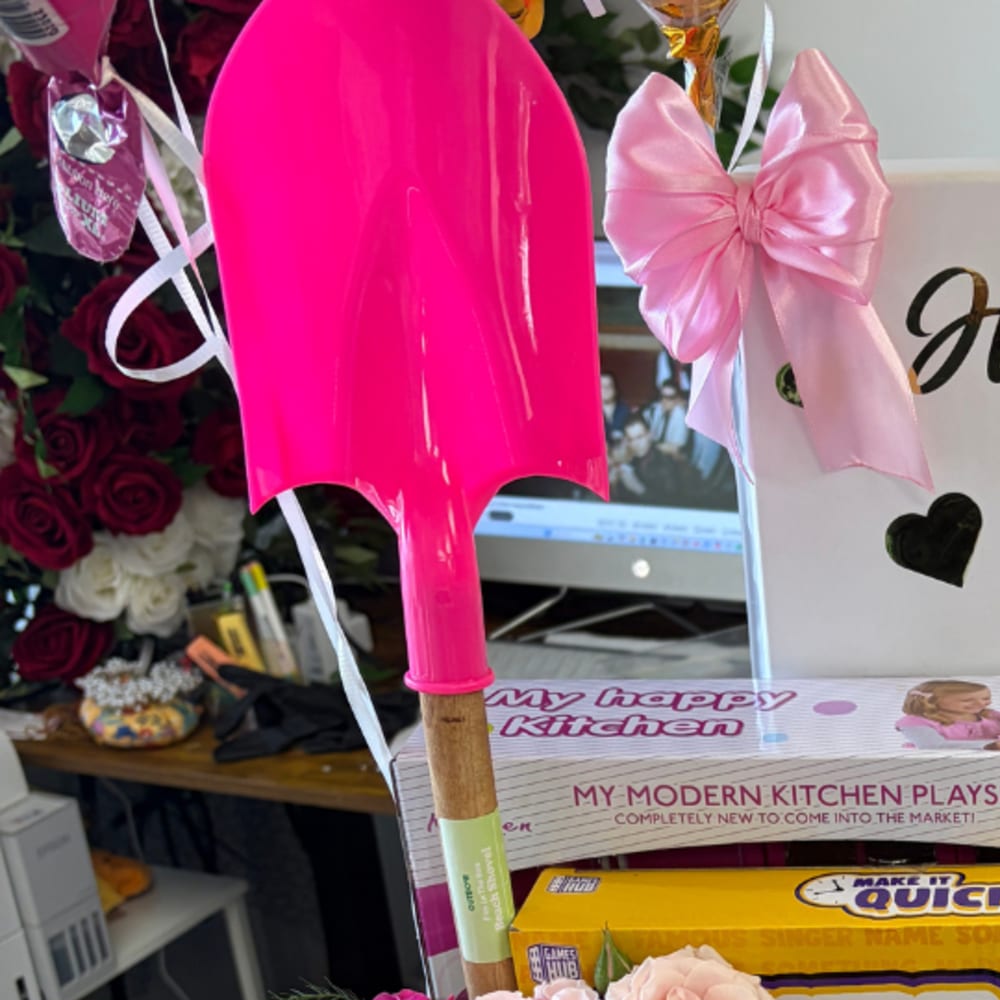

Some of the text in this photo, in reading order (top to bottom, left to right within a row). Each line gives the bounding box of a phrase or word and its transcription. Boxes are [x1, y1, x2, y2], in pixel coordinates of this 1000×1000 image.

[485, 687, 798, 712] My happy
[500, 713, 745, 738] Kitchen
[573, 785, 615, 807] MY
[627, 784, 761, 807] MODERN
[772, 784, 908, 807] KITCHEN
[614, 812, 975, 826] COMPLETELY NEW TO COME INTO THE MARKET!
[852, 875, 952, 887] MAKE IT
[759, 928, 851, 948] SINGER
[864, 926, 944, 947] NAME
[543, 946, 577, 960] GAMES
